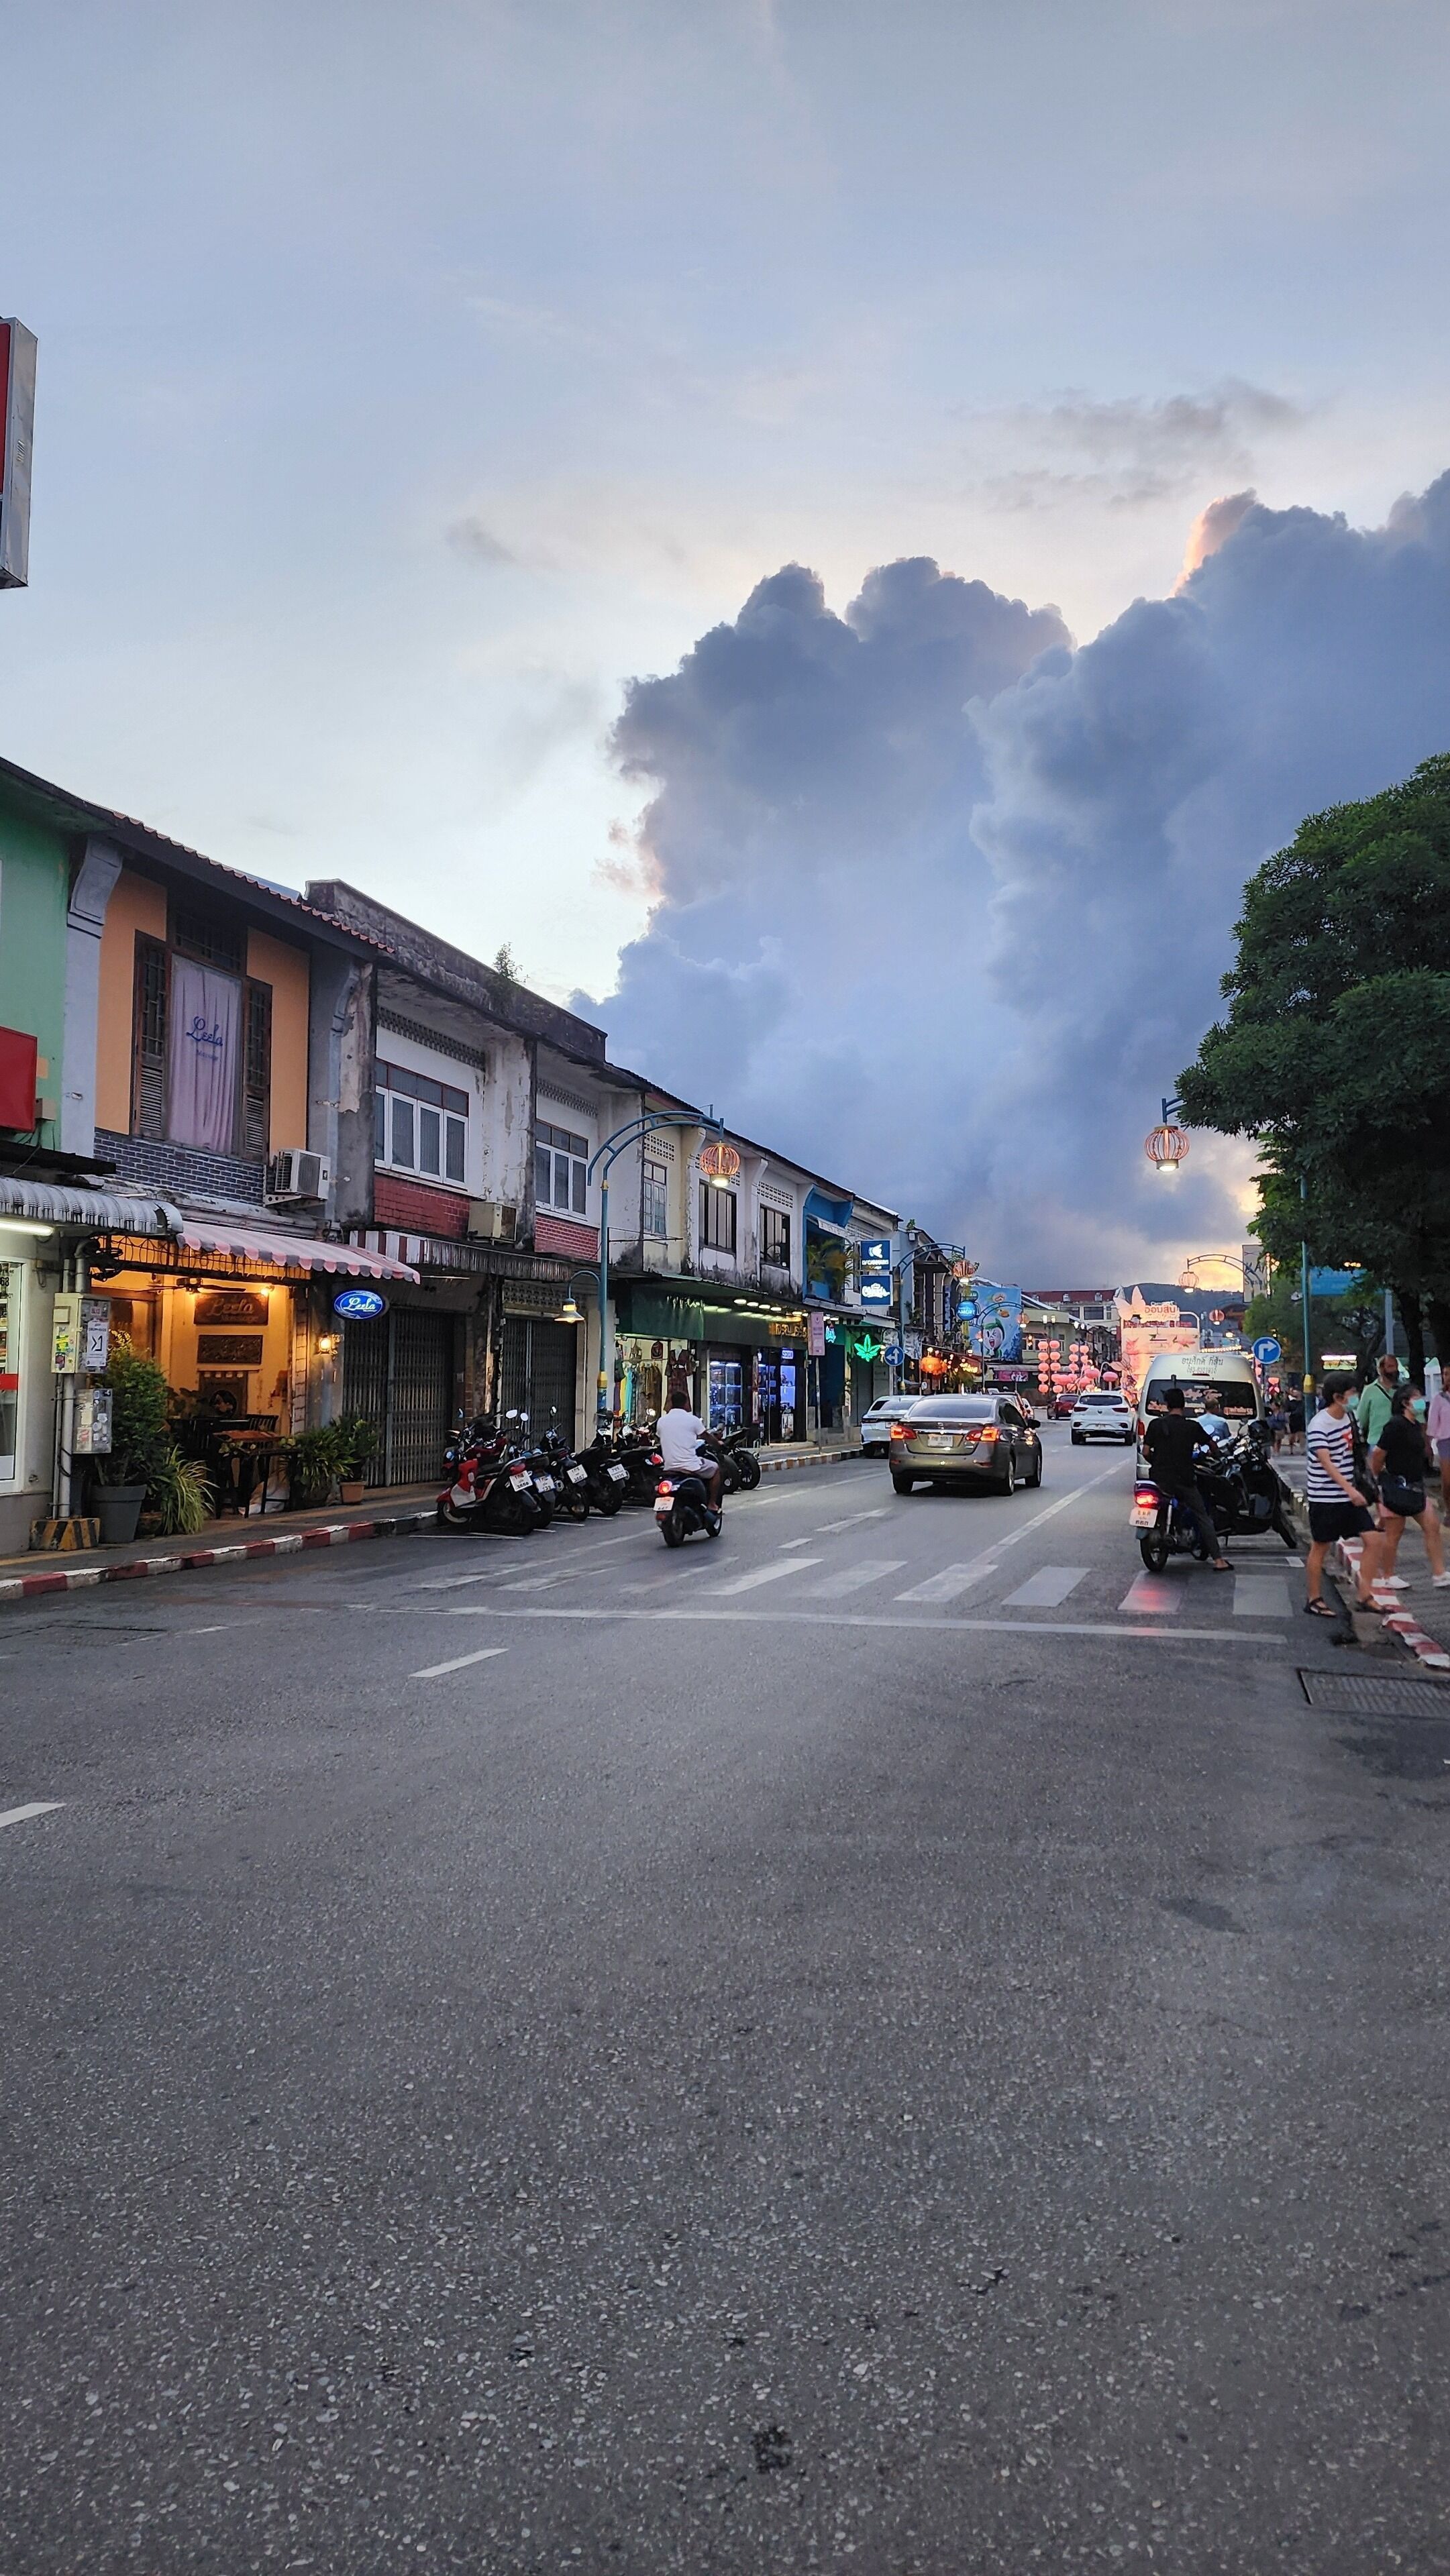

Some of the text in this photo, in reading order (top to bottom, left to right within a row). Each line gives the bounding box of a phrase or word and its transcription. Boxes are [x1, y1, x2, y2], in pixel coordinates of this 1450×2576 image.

[187, 1016, 223, 1046] Leela
[206, 1299, 255, 1316] Leela
[343, 1297, 376, 1311] Leela
